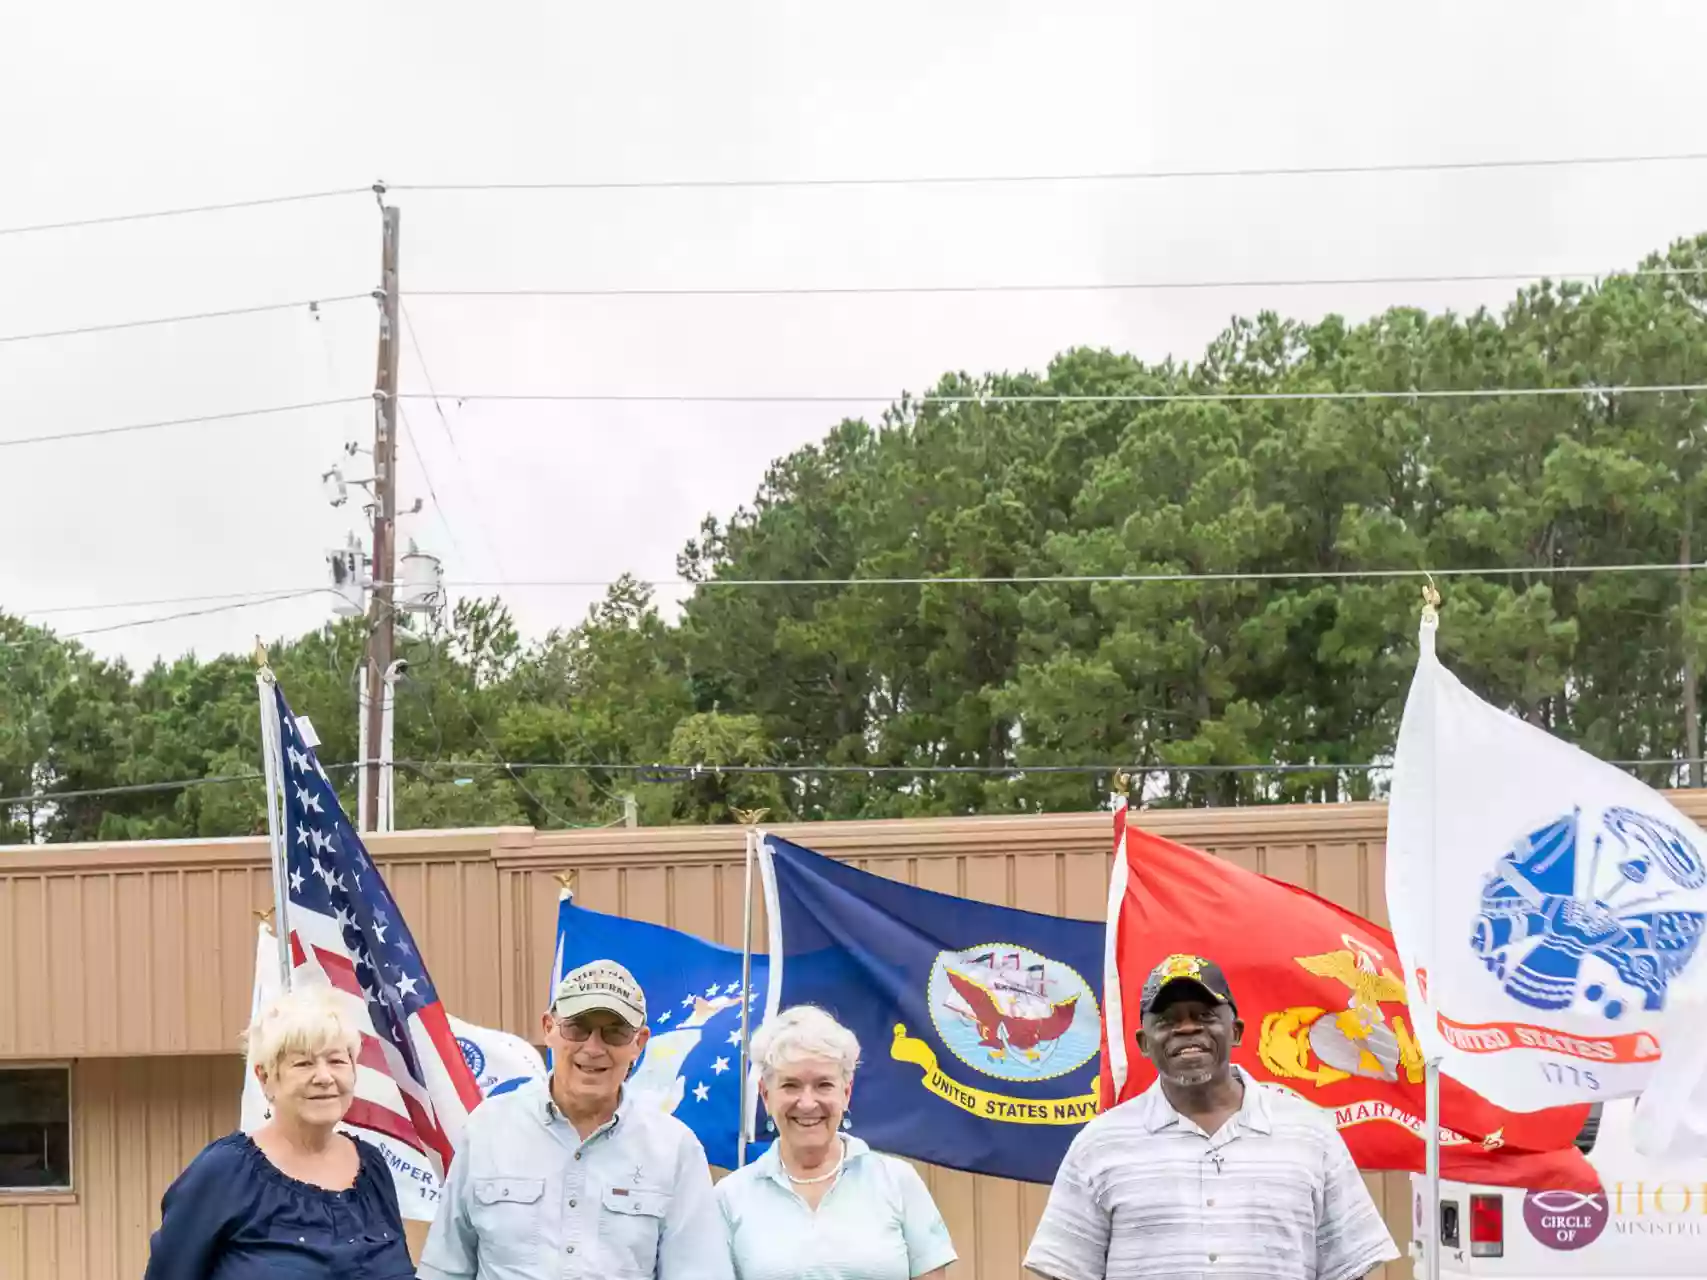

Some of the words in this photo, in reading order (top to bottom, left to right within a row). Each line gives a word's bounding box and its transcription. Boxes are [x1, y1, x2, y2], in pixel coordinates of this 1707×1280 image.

[579, 982, 631, 999] VETERAN
[1540, 1061, 1600, 1091] 1775
[931, 1072, 977, 1109] UNITED
[985, 1100, 1048, 1119] STATES
[1054, 1100, 1099, 1119] NAVY
[1334, 1102, 1422, 1131] MARINE
[380, 1142, 433, 1185] SEMPER
[420, 1187, 443, 1202] 17
[1616, 1181, 1707, 1216] HO
[1541, 1215, 1592, 1229] CIRCLE
[1556, 1229, 1577, 1242] OF
